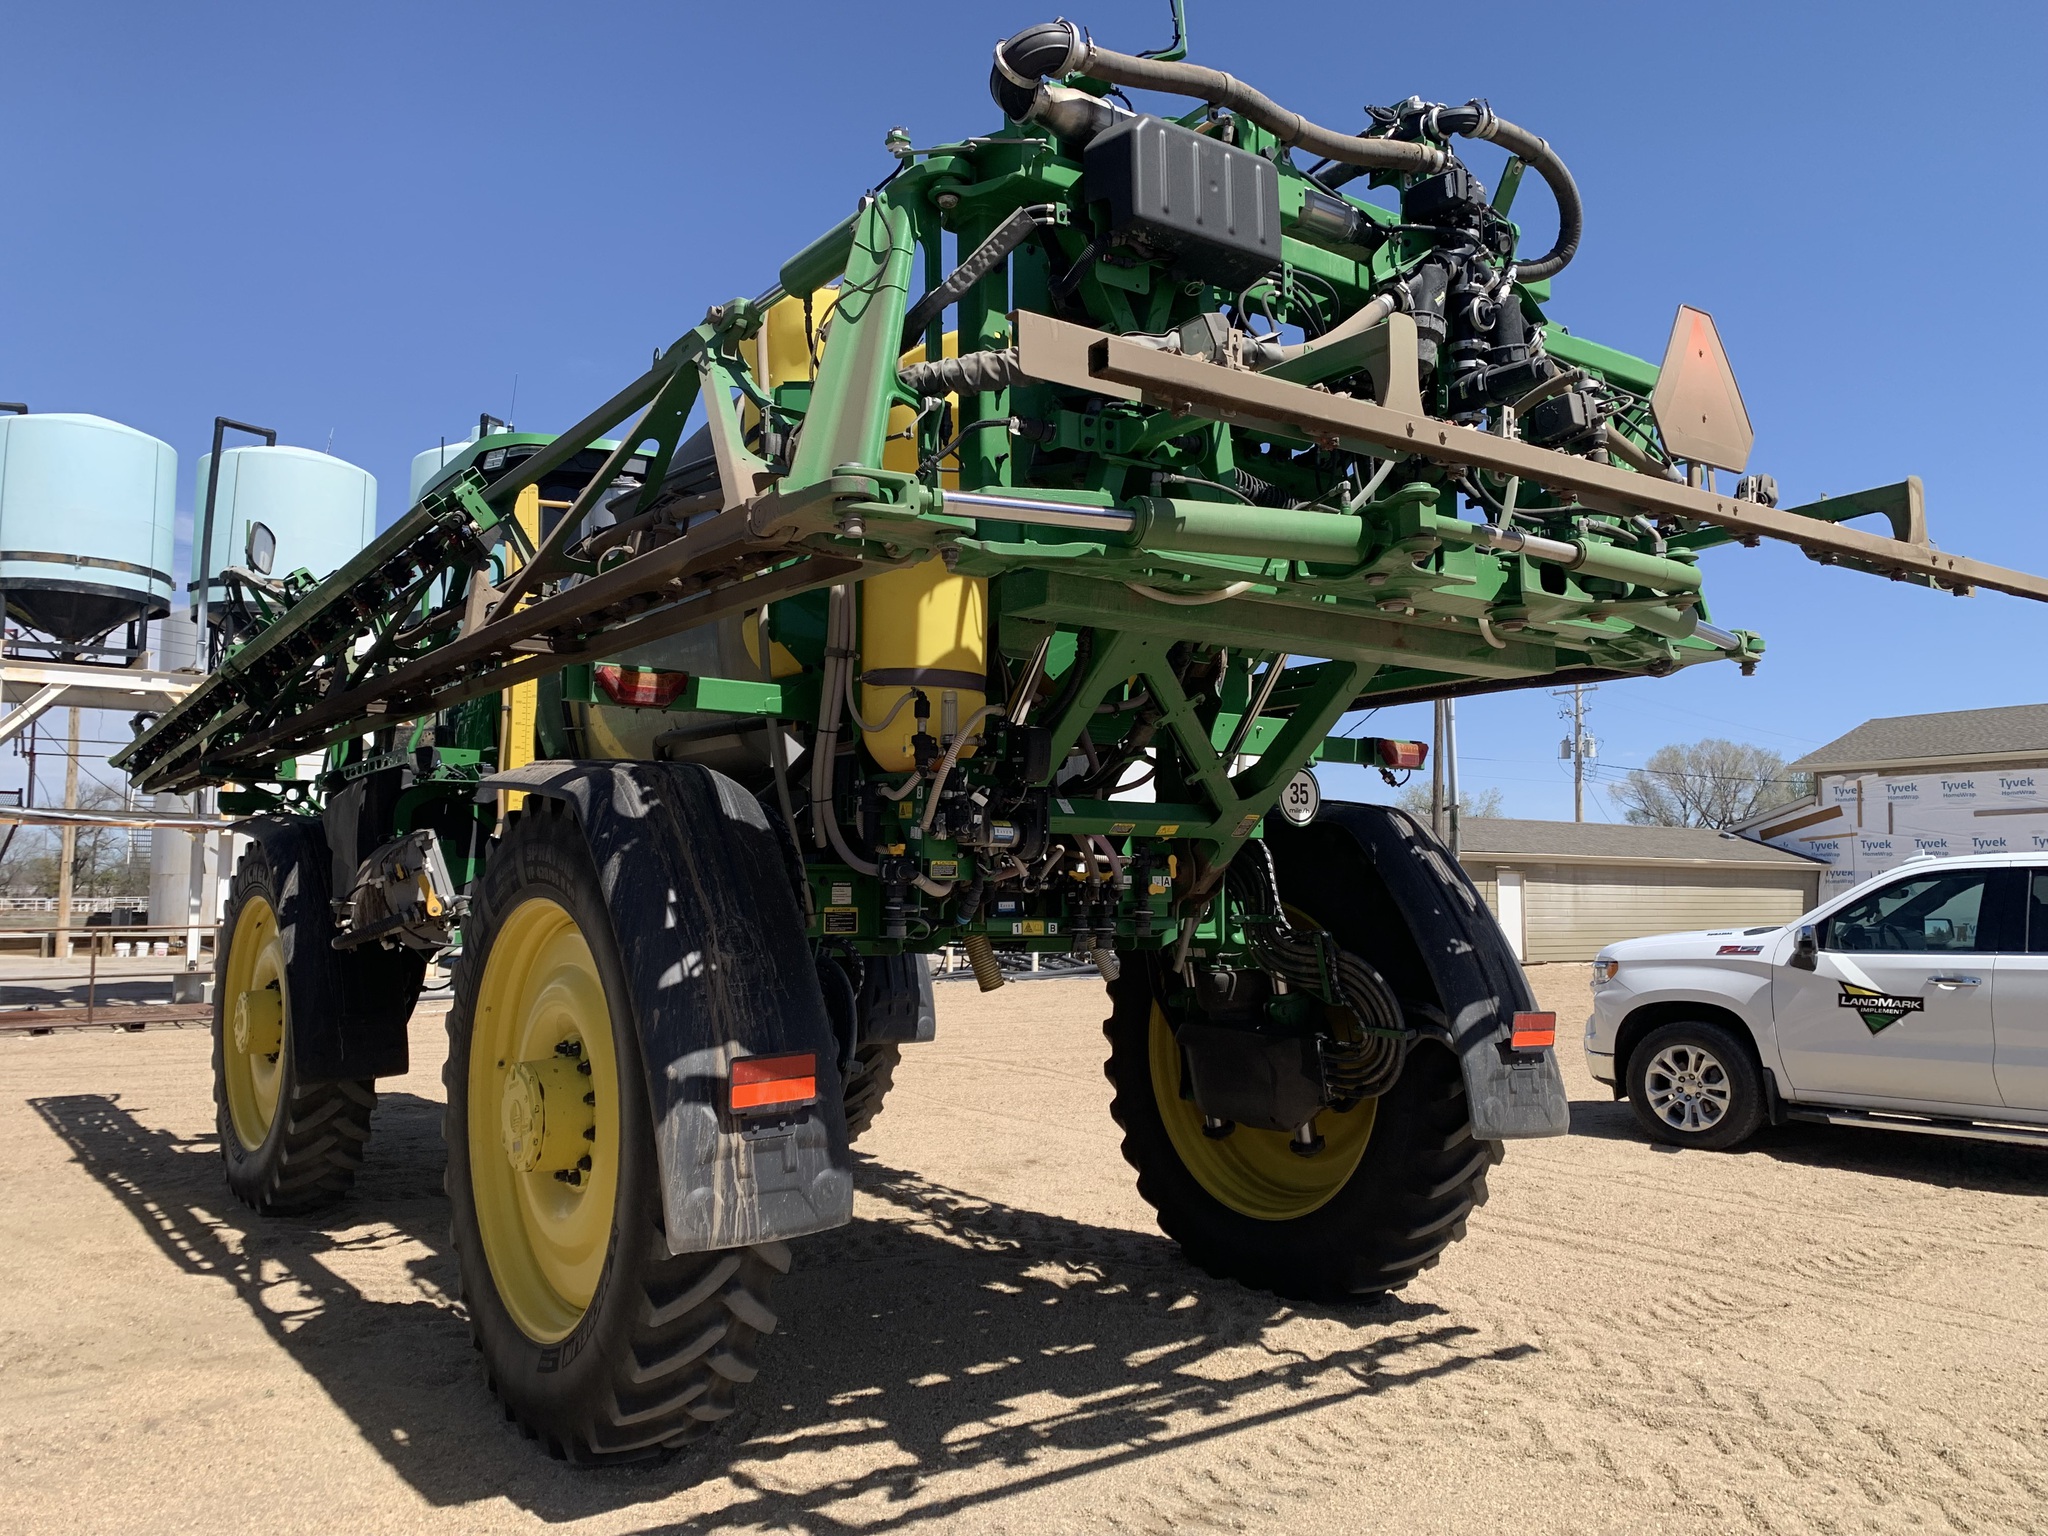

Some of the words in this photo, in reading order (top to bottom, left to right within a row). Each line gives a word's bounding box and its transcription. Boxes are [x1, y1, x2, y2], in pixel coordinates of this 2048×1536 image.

[1885, 782, 1918, 794] Tyvek
[1941, 780, 1975, 792] Tyvek
[1999, 777, 2035, 790] Tyvek
[1290, 782, 1309, 805] 35
[1833, 786, 1863, 797] Tyve
[1810, 841, 1839, 851] Tyvek
[1860, 840, 1892, 851] Tyvek
[1914, 838, 1948, 849] Tyvek
[1972, 837, 2007, 849] Tyvek
[1163, 877, 1170, 886] A
[1050, 924, 1056, 933] B
[1860, 1007, 1904, 1015] IMPLEMENT
